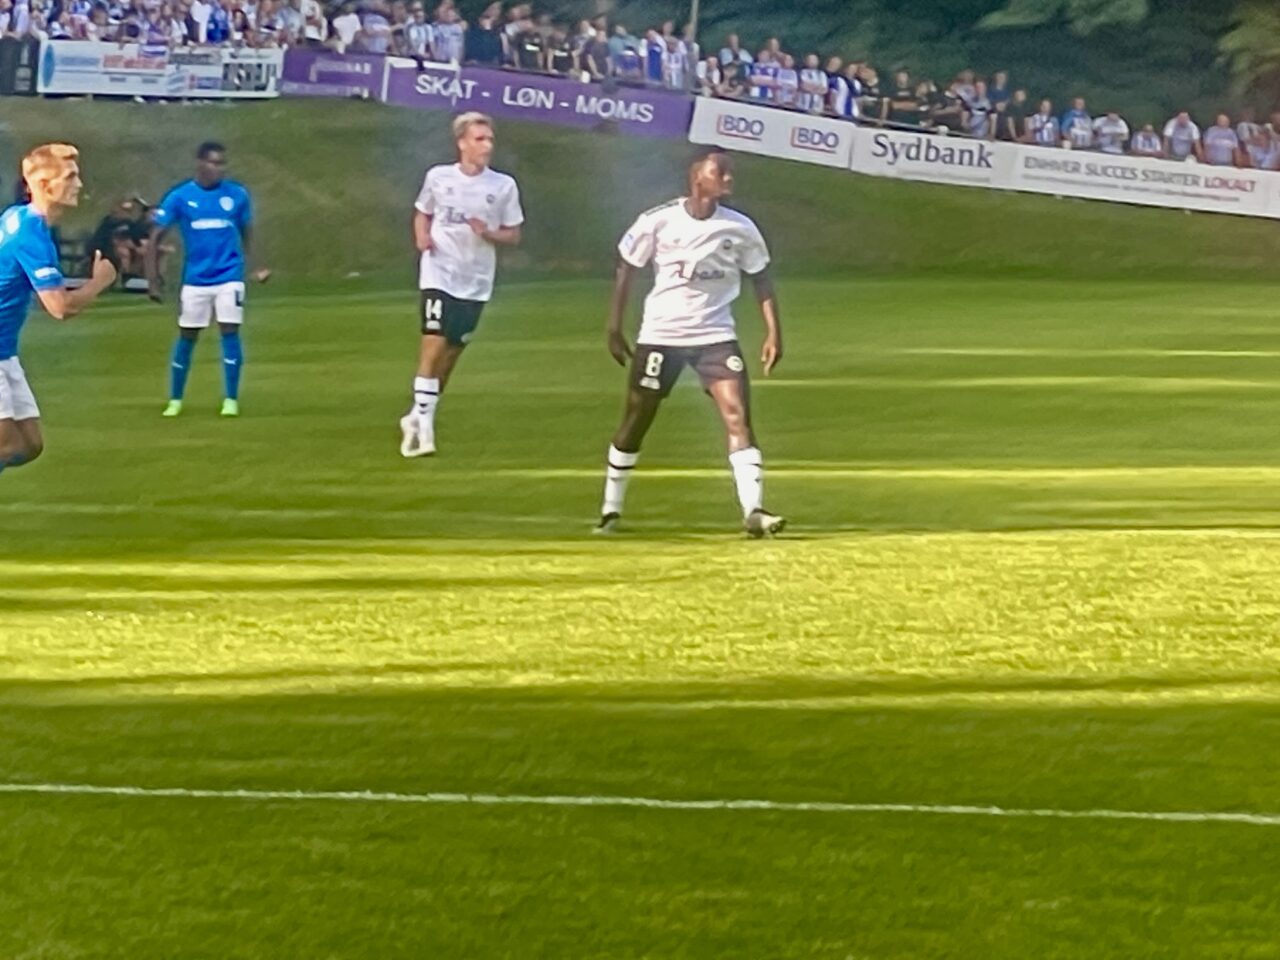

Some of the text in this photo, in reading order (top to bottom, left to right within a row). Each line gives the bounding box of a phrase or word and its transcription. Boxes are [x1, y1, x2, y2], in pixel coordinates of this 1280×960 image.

[415, 74, 478, 100] SKAT
[503, 85, 555, 110] LØN
[575, 95, 655, 124] MOMS
[723, 114, 765, 137] BDO
[796, 126, 839, 149] BDO
[871, 133, 995, 169] Sydbank
[425, 298, 443, 320] 14
[645, 351, 665, 377] 8
